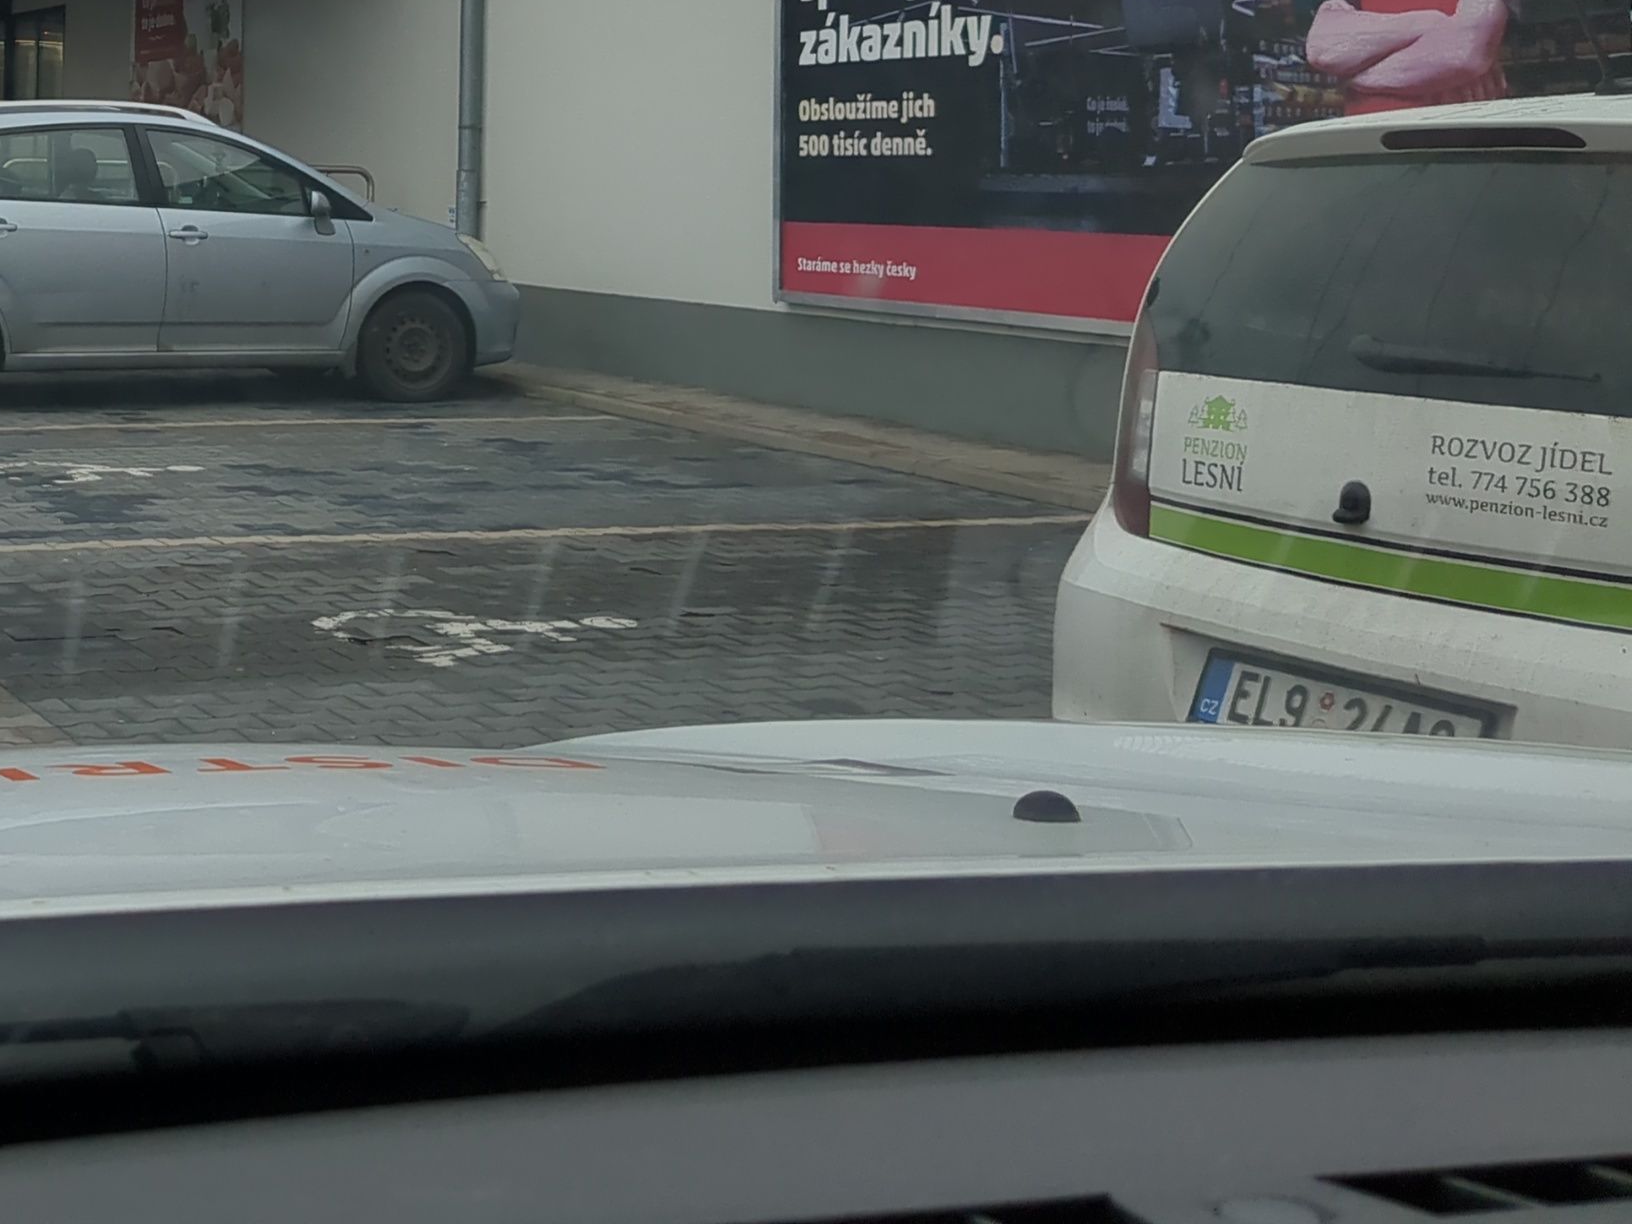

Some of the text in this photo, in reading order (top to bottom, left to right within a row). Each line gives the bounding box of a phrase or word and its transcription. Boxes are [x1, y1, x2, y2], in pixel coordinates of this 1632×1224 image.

[798, 1, 1005, 67] zákazníky.
[798, 91, 935, 124] Obsloužíme jich
[799, 128, 933, 156] 500 tisíc denně.
[797, 255, 917, 281] Staráme se hezky česky
[1183, 436, 1247, 461] PENZION
[1430, 435, 1613, 475] ROZVOZ JÍDEL
[1182, 458, 1245, 492] LESNÍ
[1428, 466, 1611, 508] tel. 774 756 388
[1425, 492, 1609, 528] www.penzion-lesni.cz
[1200, 698, 1217, 716] CZ
